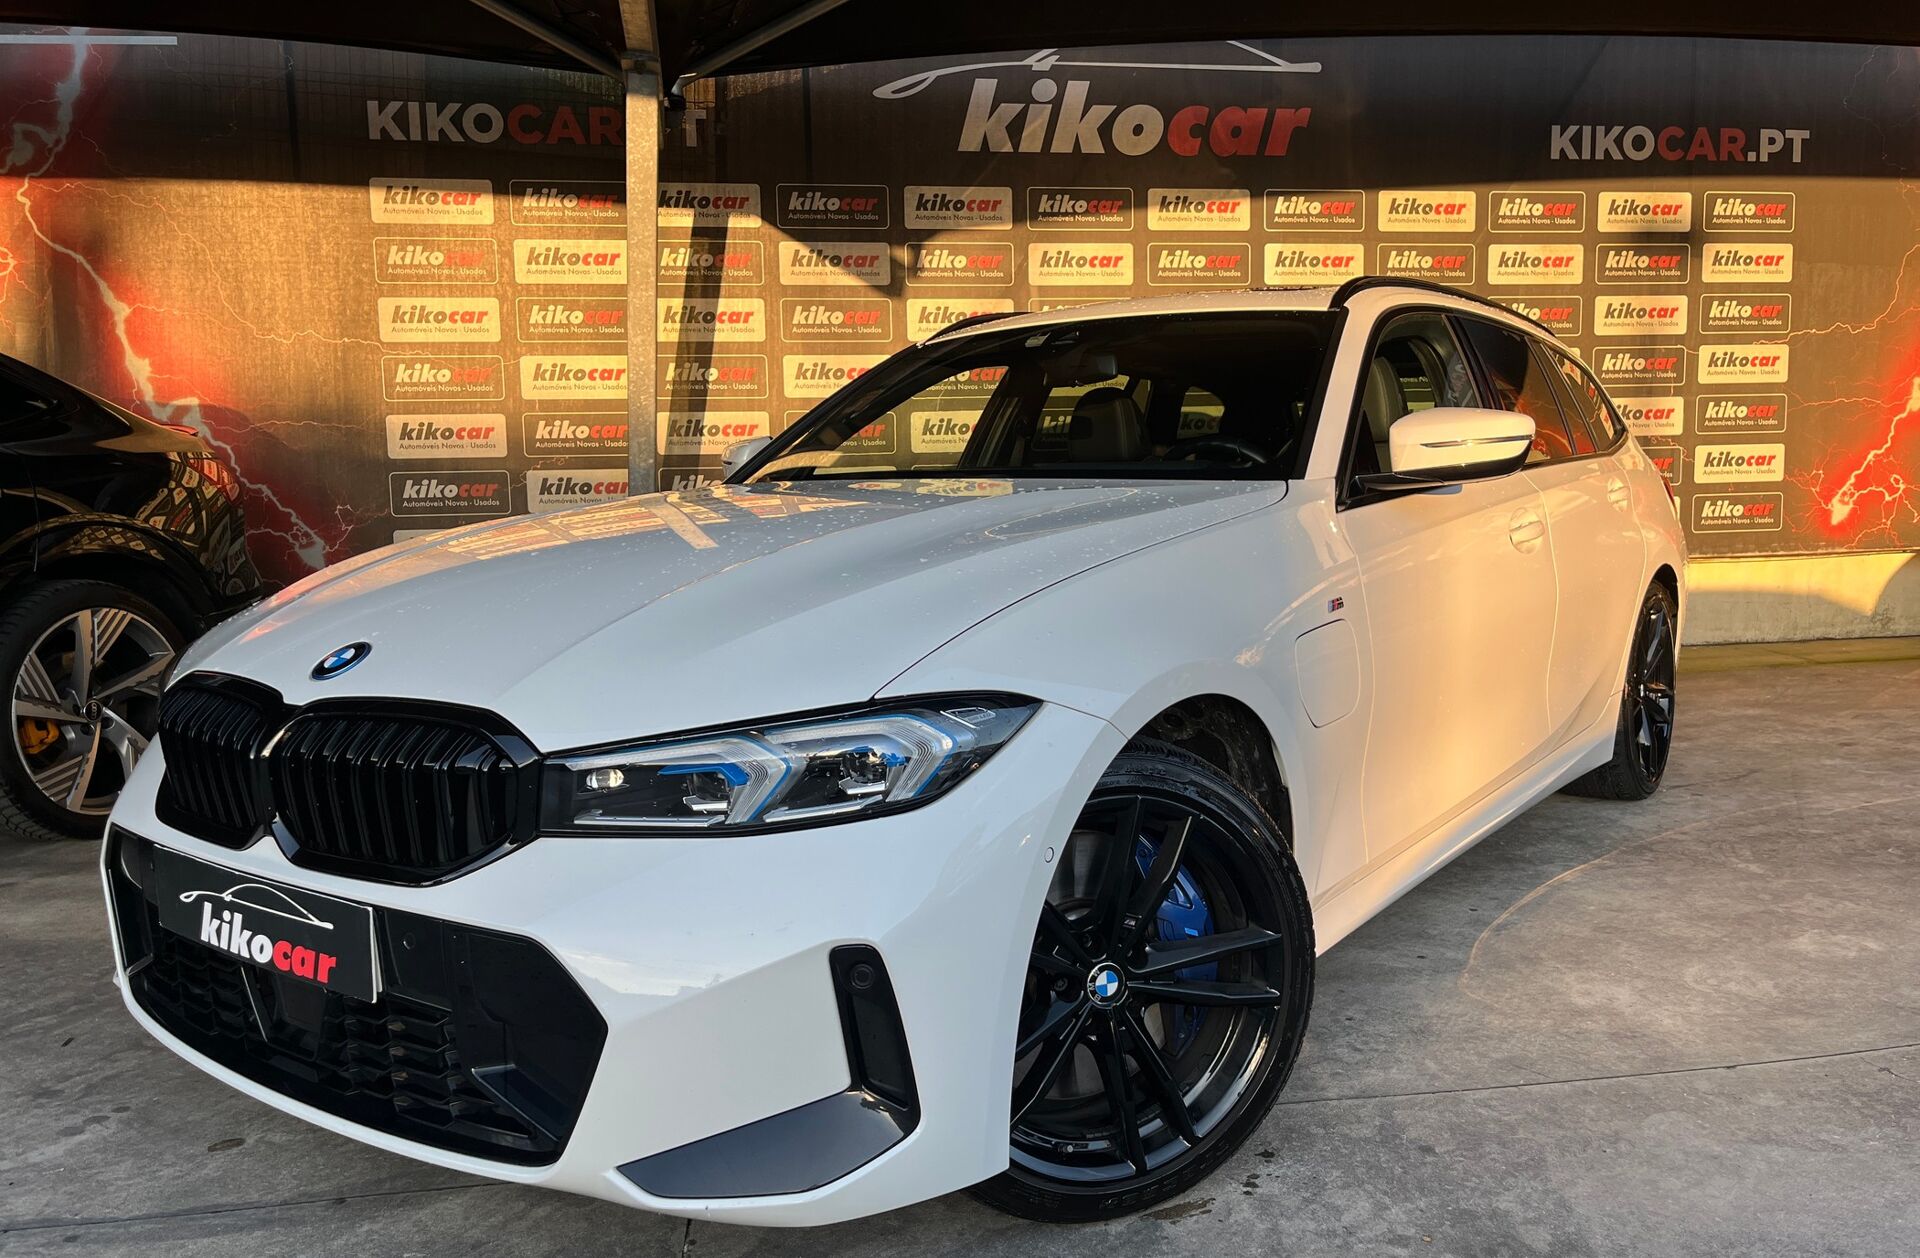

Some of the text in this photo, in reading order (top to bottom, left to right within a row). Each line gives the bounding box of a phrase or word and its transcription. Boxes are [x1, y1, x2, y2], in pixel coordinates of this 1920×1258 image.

[366, 99, 707, 147] KIKOCART
[957, 77, 1312, 157] kikocar
[1550, 125, 1810, 163] KIKOCAR.PT
[384, 186, 481, 205] kikocar
[523, 189, 617, 208] kikocar
[658, 191, 749, 209] kikocar
[789, 192, 878, 210] kikocar
[916, 194, 1002, 211] kikocar
[1039, 195, 1122, 213] kikocar
[1159, 196, 1240, 213] kikocar
[1275, 197, 1355, 215] kikocar
[1388, 198, 1466, 215] kikocar
[1499, 199, 1576, 216] kikocar
[1608, 199, 1682, 216] kikocar
[1713, 199, 1787, 215] kikocar
[388, 246, 484, 265] kikocar
[527, 247, 620, 265] kikocar
[660, 248, 752, 267] kikocar
[791, 250, 879, 267] kikocar
[917, 250, 1003, 268] kikocar
[1040, 251, 1123, 268] kikocar
[1159, 251, 1241, 268] kikocar
[1275, 251, 1354, 268] kikocar
[1388, 251, 1465, 268] kikocar
[1498, 252, 1574, 268] kikocar
[1605, 251, 1680, 268] kikocar
[1712, 250, 1784, 266] kikocar
[431, 267, 454, 275] Novos
[460, 267, 487, 275] Usados
[728, 269, 753, 277] Usados
[392, 305, 488, 324] kikocar
[529, 305, 624, 324] kikocar
[664, 306, 753, 324] kikocar
[793, 306, 880, 324] kikocar
[1604, 303, 1679, 319] kikocar
[1709, 301, 1782, 318] kikocar
[1602, 354, 1677, 370] kikocar
[1708, 352, 1780, 367] kikocar
[396, 364, 492, 382] kikocar
[533, 364, 625, 381] kikocar
[666, 363, 756, 381] kikocar
[467, 384, 493, 392] Usados
[1705, 402, 1779, 419] kikocar
[400, 423, 494, 440] kikocar
[536, 421, 627, 439] kikocar
[669, 419, 759, 437] kikocar
[1704, 452, 1776, 467] kikocar
[403, 480, 497, 498] kikocar
[445, 499, 468, 507] Novos
[1702, 500, 1774, 517] kikocar
[200, 901, 337, 984] kikocar
